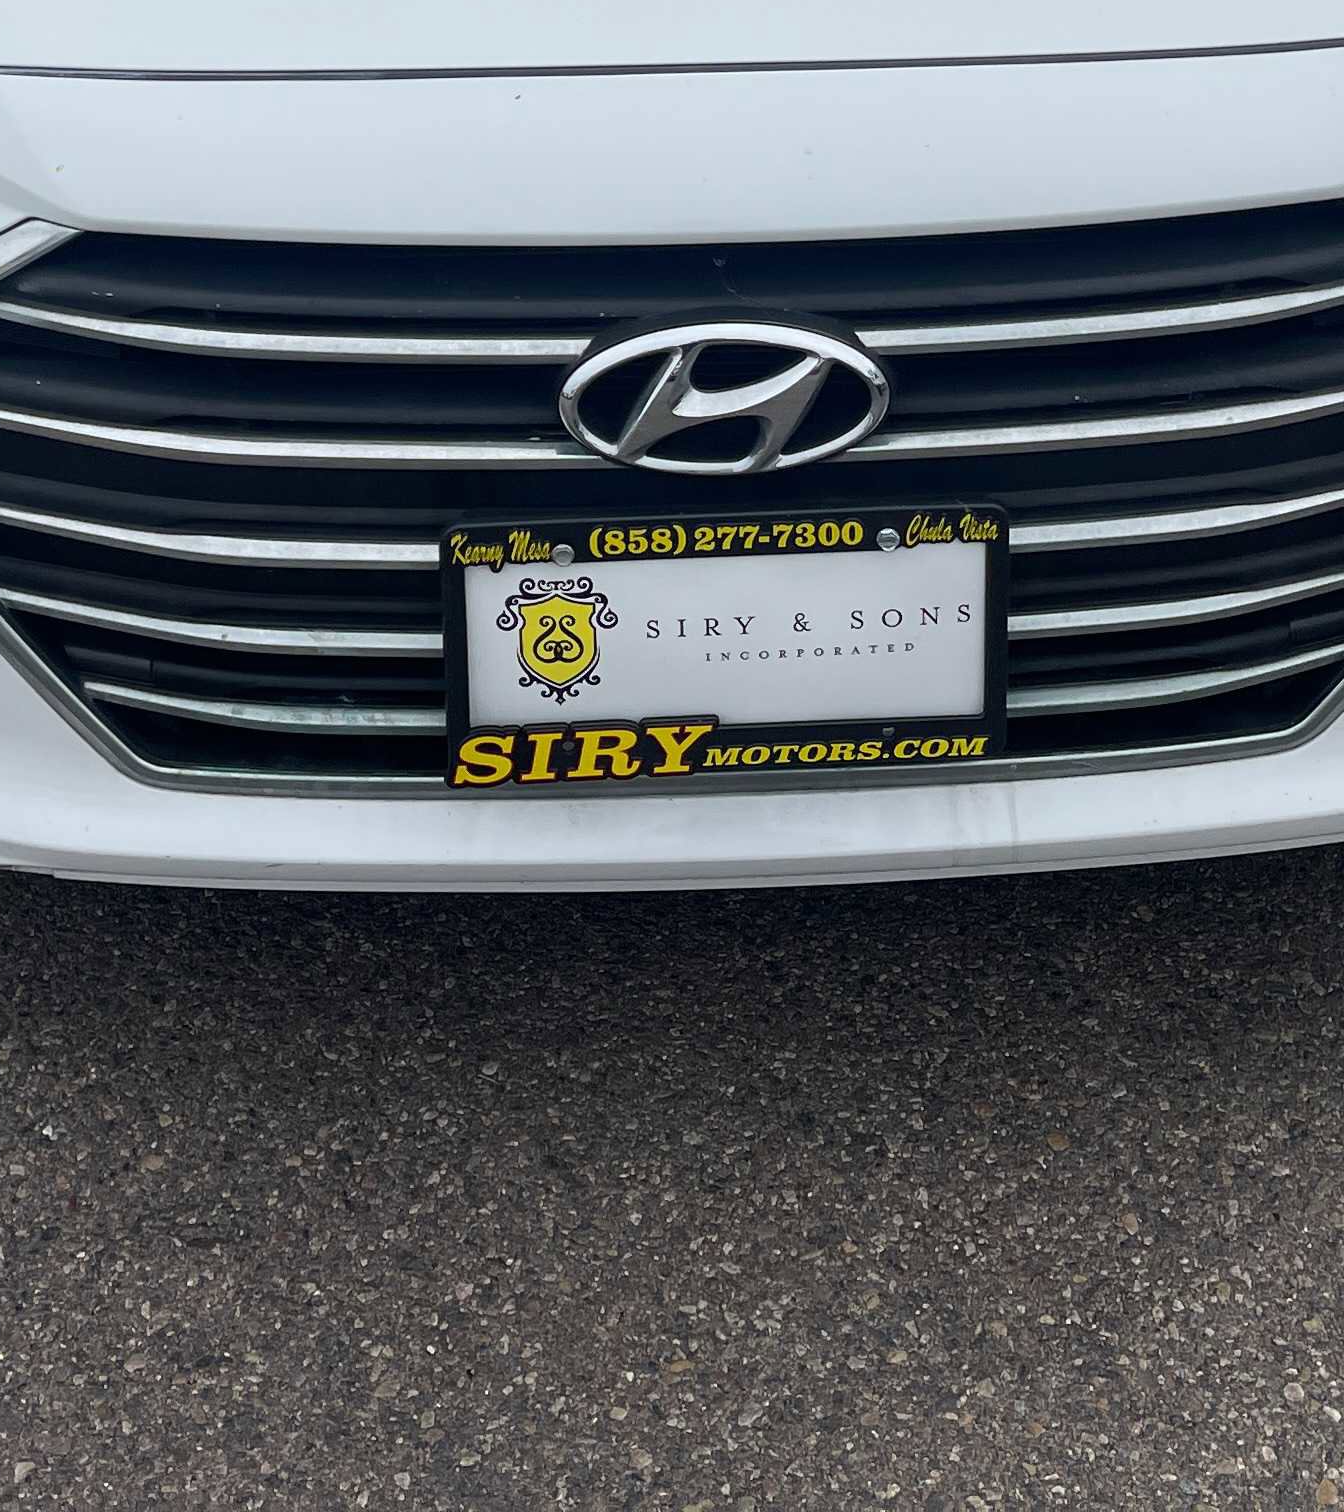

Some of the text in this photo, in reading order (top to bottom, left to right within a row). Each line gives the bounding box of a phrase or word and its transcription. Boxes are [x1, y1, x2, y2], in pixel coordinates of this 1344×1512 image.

[509, 529, 552, 562] Mesa
[905, 513, 999, 547] Chula Vista
[645, 604, 972, 639] SIRY & SONS
[705, 642, 916, 662] INCORPORATED
